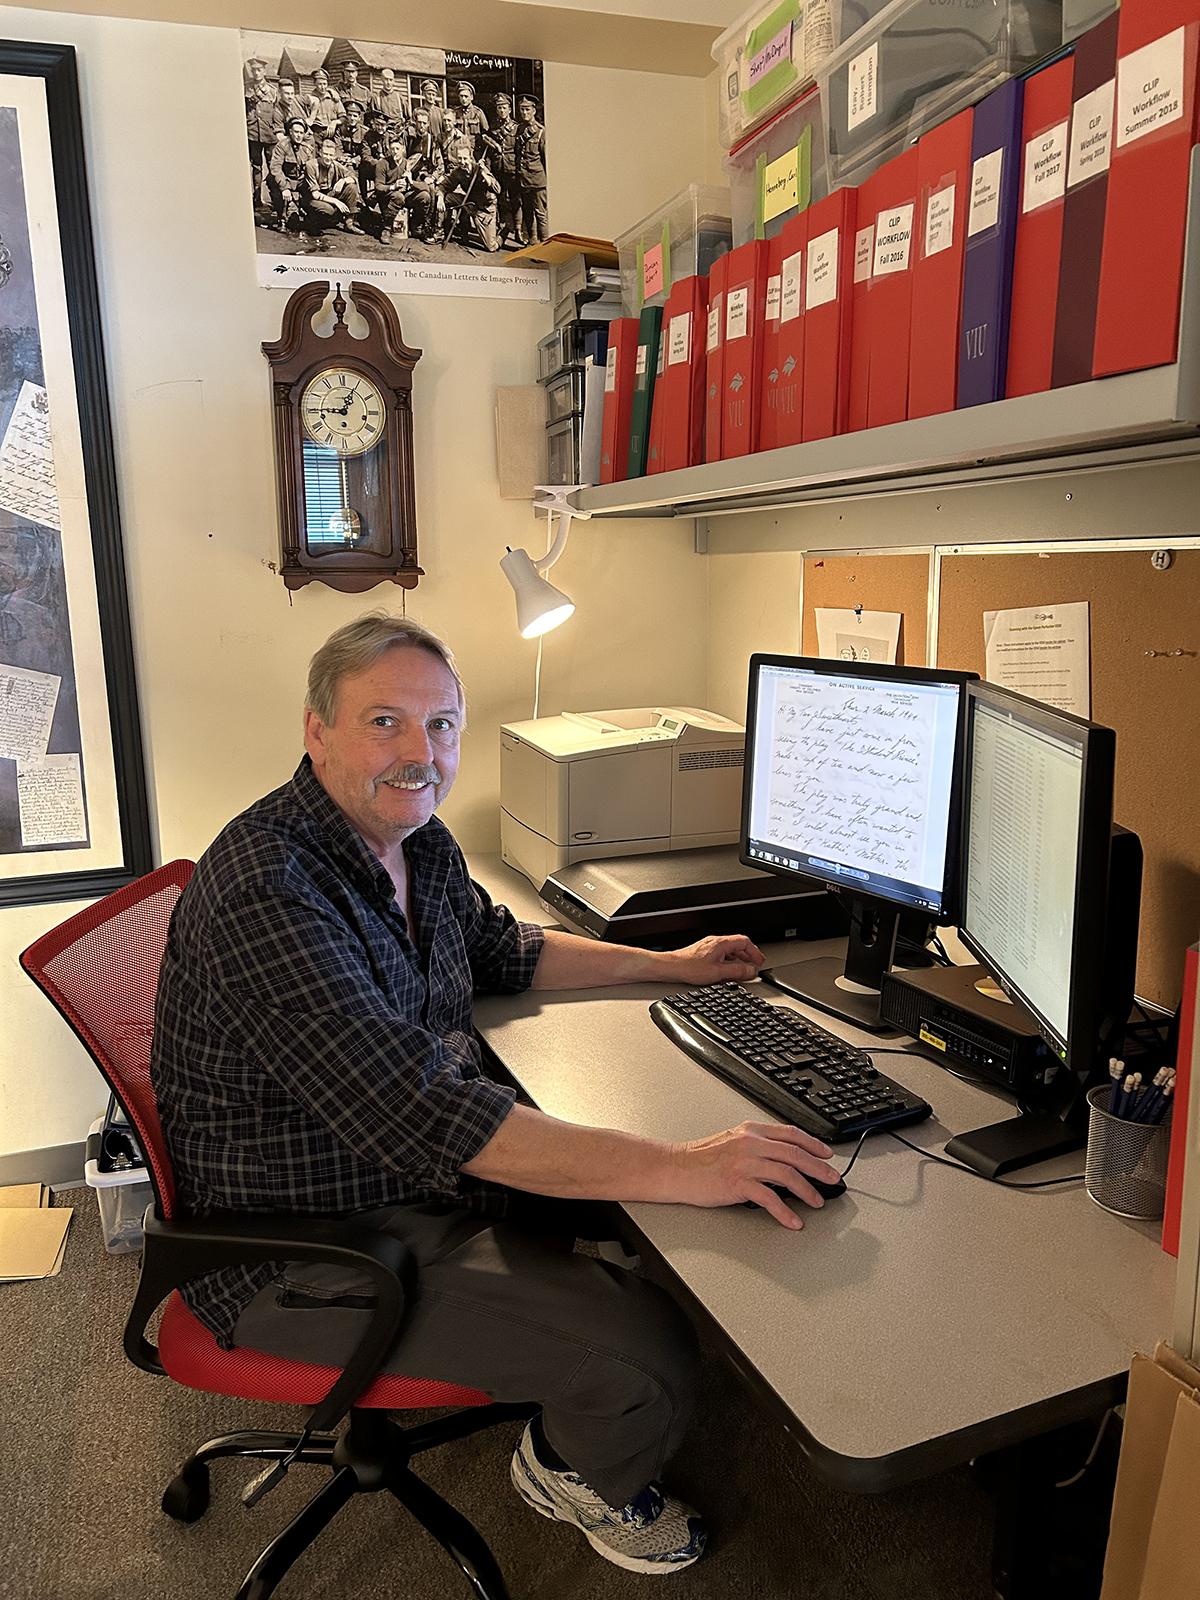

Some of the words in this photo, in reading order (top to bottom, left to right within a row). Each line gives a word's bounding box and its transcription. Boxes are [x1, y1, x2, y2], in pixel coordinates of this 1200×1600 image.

[444, 51, 472, 68] Witley
[473, 54, 493, 69] Camp
[1143, 78, 1160, 94] CLIP
[1132, 89, 1171, 115] Workflow
[1088, 115, 1102, 130] CLIP
[1125, 112, 1157, 136] Summer
[1158, 100, 1178, 118] 2018
[1041, 139, 1054, 152] CLIP
[1080, 131, 1108, 151] Workflow
[1034, 150, 1061, 170] Workflow
[1079, 154, 1093, 167] Spring
[1034, 172, 1046, 184] Fall
[1046, 163, 1060, 178] 2017
[931, 200, 940, 210] CLIP
[931, 207, 950, 220] Workflow
[888, 216, 901, 228] CLIP
[877, 230, 911, 247] WORKFLOW
[880, 254, 890, 265] Fall
[890, 251, 904, 262] 2016
[292, 266, 328, 274] VANCOUVER
[403, 270, 417, 278] The
[419, 271, 453, 280] Canadian
[454, 273, 479, 281] Letters
[480, 274, 488, 282] &
[489, 275, 513, 285] Images
[515, 276, 539, 286] Project
[965, 324, 988, 360] VIU
[729, 400, 745, 428] VIU
[801, 735, 810, 746] the
[807, 739, 828, 754] play
[816, 721, 834, 733] have
[834, 727, 863, 742] just
[863, 732, 880, 741] come
[890, 733, 916, 750] from
[816, 757, 829, 770] of
[847, 763, 870, 773] and
[868, 768, 886, 777] now
[793, 782, 807, 795] The
[807, 789, 828, 806] play
[833, 795, 847, 804] was
[851, 794, 872, 814] truly
[870, 805, 909, 816] grand
[770, 798, 806, 817] something
[821, 807, 842, 820] have
[847, 814, 869, 828] often
[872, 823, 905, 834] wanted
[904, 829, 919, 839] to
[767, 828, 779, 838] the
[780, 833, 804, 842] part
[801, 837, 815, 850] of
[804, 821, 828, 832] could
[829, 825, 857, 838] almost
[858, 833, 870, 842] see
[871, 839, 890, 851] you
